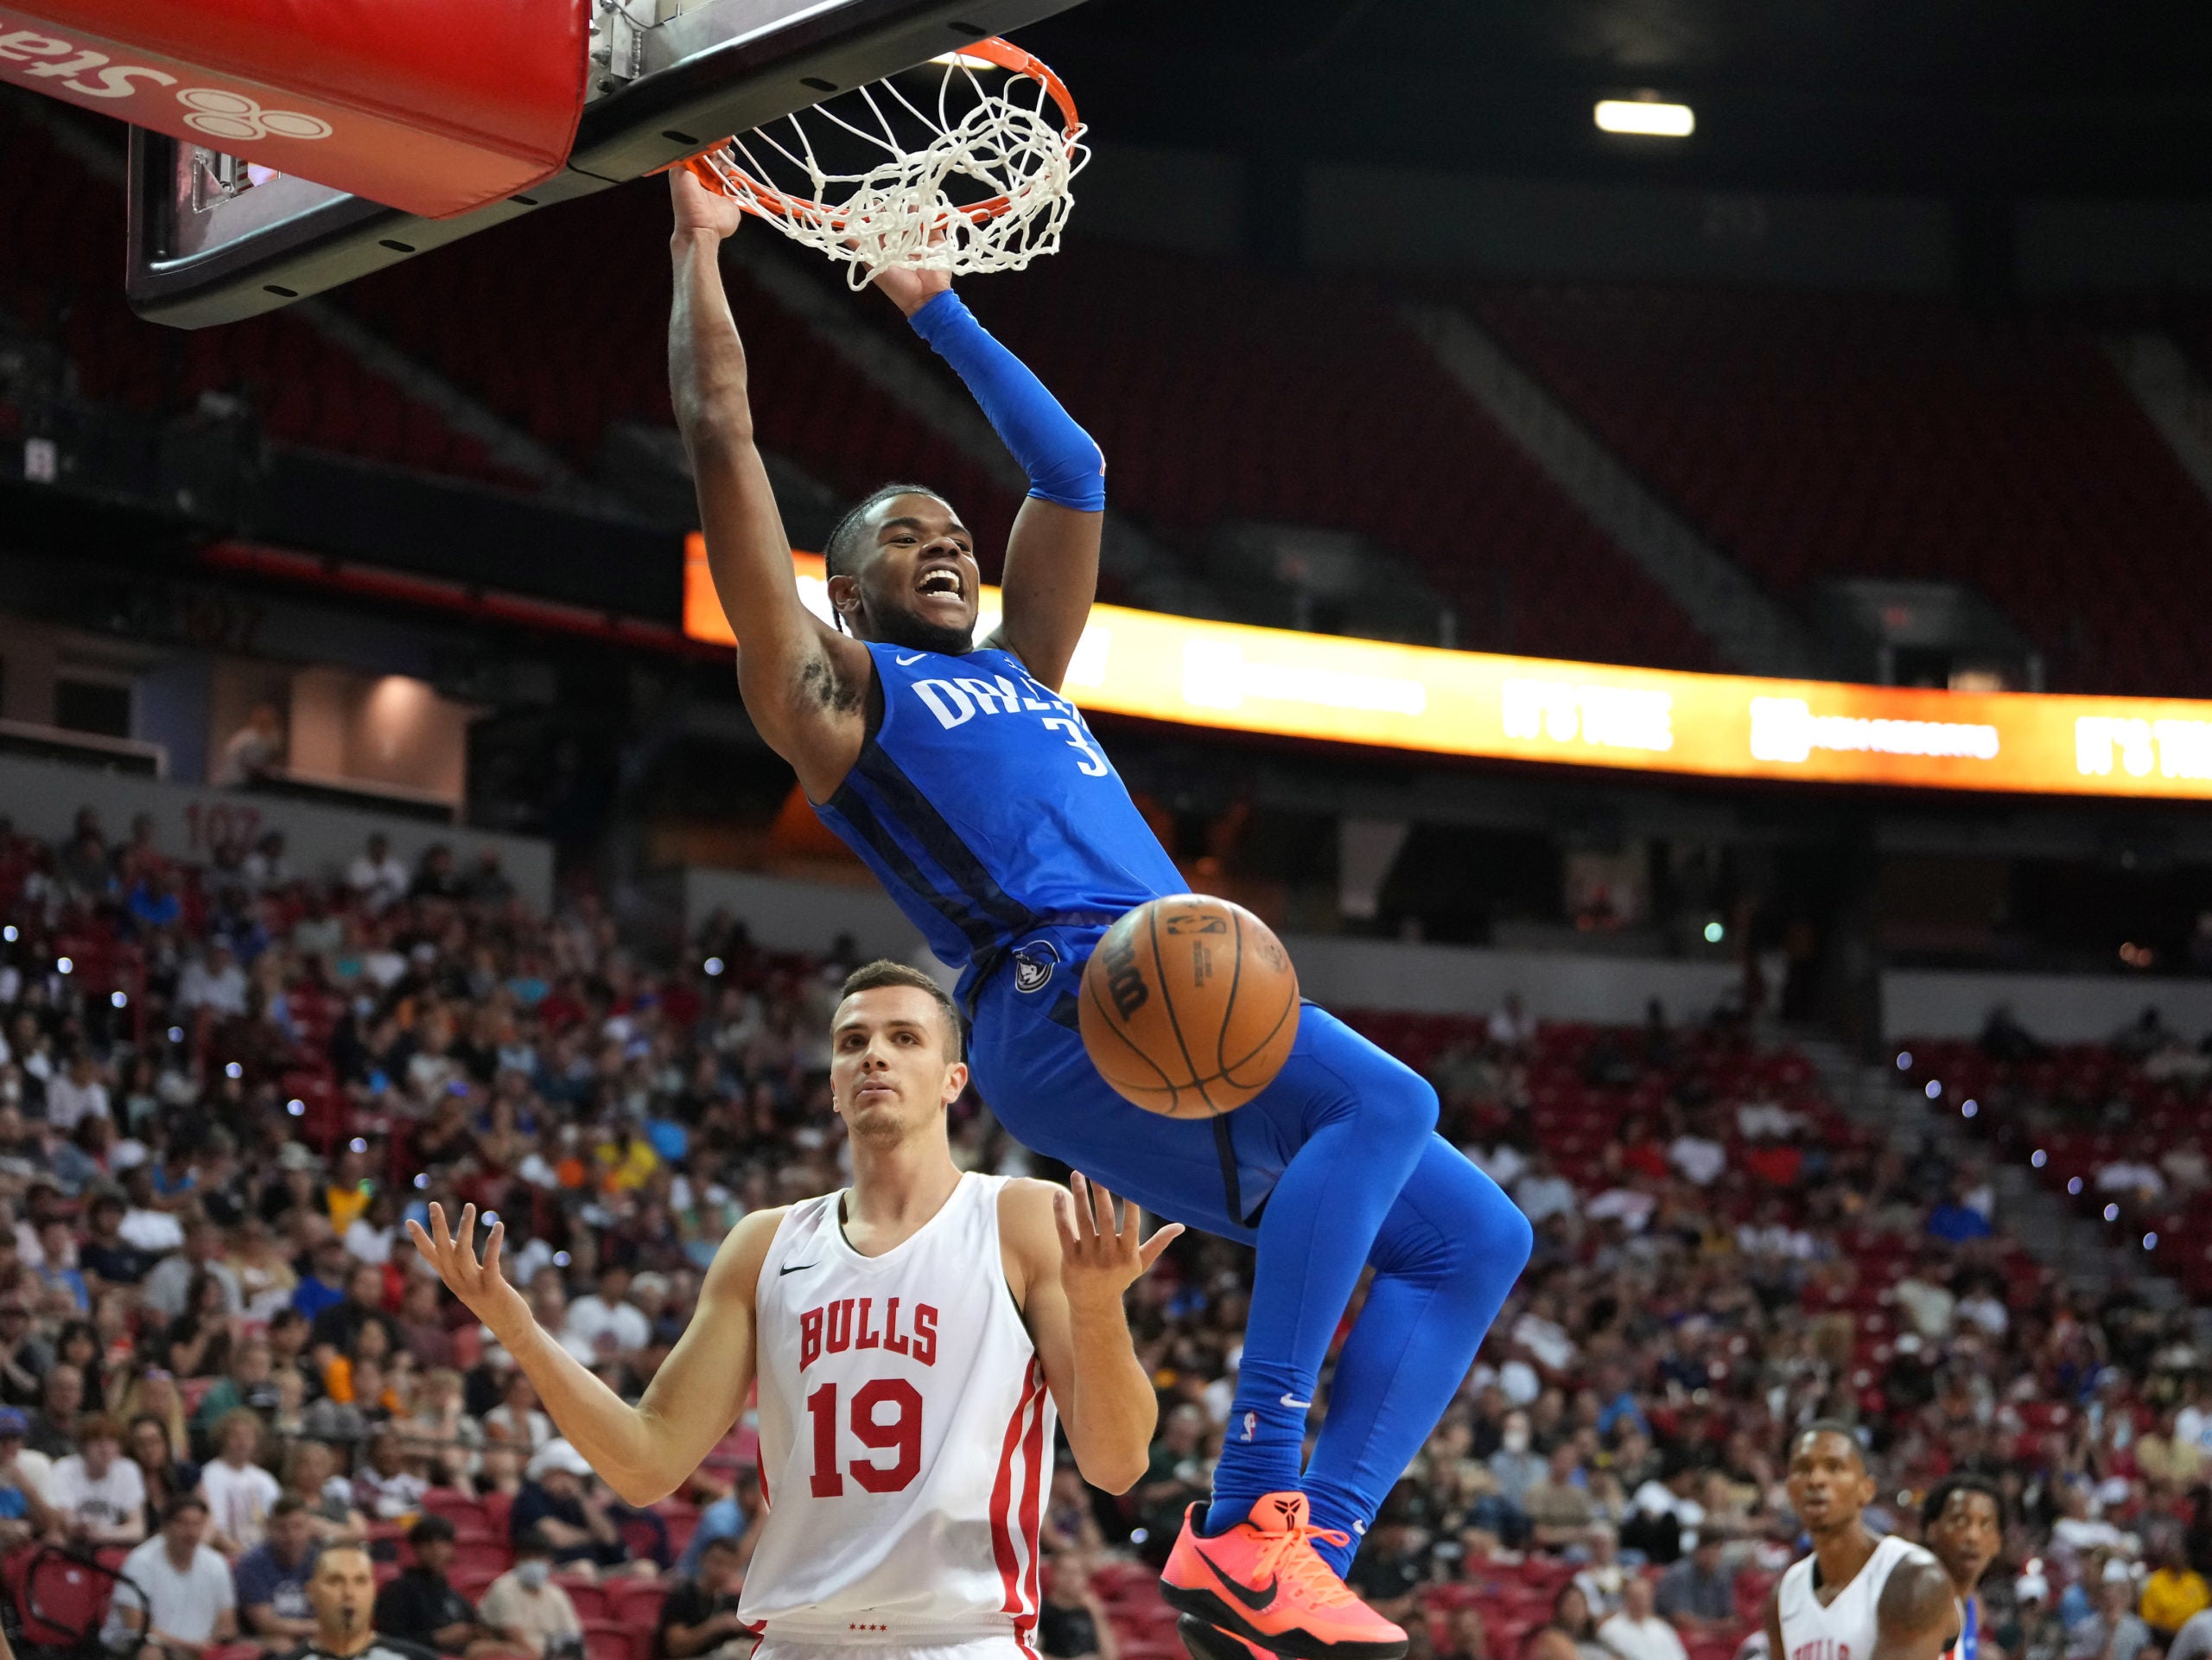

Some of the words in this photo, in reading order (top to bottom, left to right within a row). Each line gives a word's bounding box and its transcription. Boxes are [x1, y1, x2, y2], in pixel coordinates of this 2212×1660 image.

[0, 23, 178, 98] Sta
[1041, 717, 1108, 777] 3
[799, 1297, 938, 1373] BULLS
[807, 1378, 923, 1498] 19
